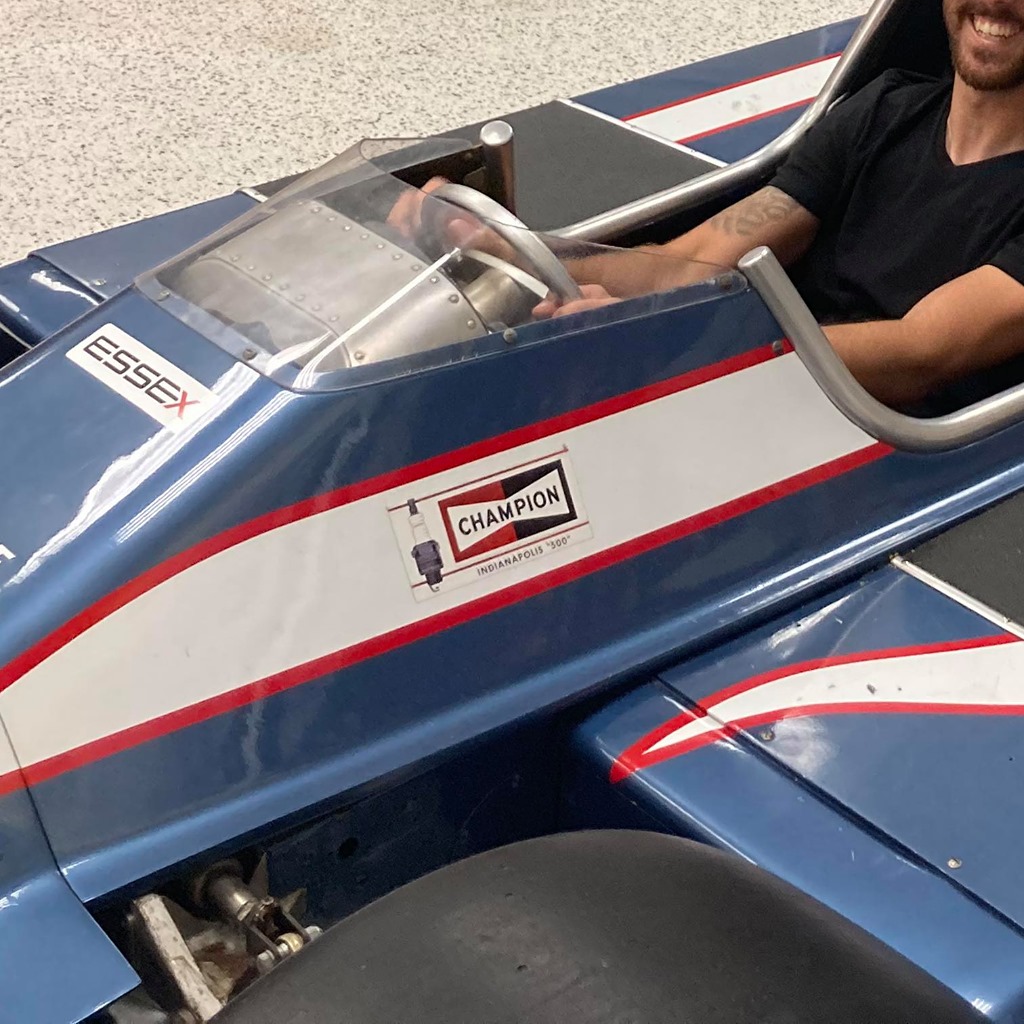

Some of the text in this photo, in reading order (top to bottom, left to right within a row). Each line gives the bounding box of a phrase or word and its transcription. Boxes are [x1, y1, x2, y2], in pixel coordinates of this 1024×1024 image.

[83, 335, 201, 419] ESSEX
[457, 484, 560, 538] CHAMPION
[476, 534, 572, 577] INDIANAPOLIS "500"
